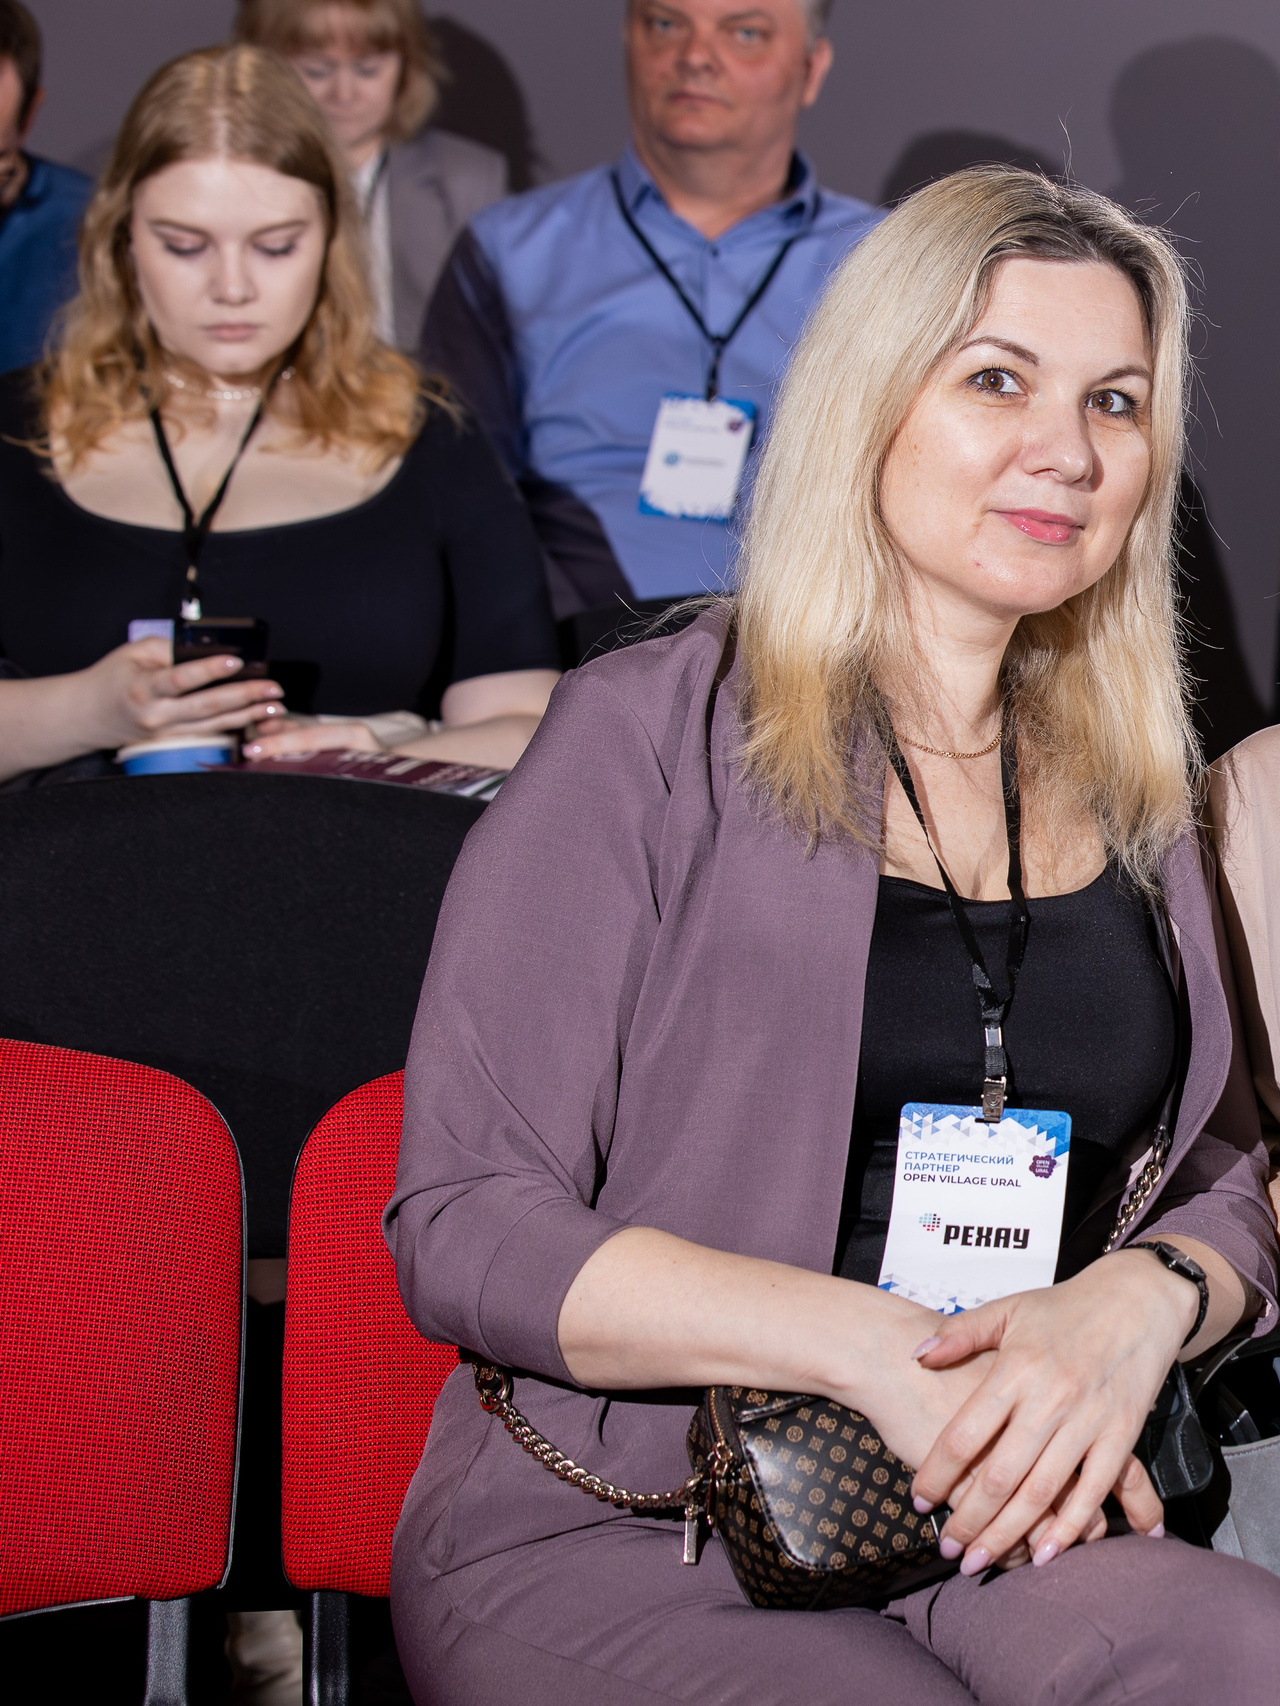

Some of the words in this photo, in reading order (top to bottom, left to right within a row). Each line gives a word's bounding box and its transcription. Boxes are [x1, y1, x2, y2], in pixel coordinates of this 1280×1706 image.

[905, 1151, 1014, 1165] СТРАТЕГИЧЕСКИЙ
[904, 1162, 960, 1173] ПАРТНЕР
[903, 1173, 936, 1183] OPEN
[939, 1175, 987, 1186] VILLAGE
[990, 1178, 1021, 1187] URAL
[943, 1224, 1030, 1249] РЕХАУ
